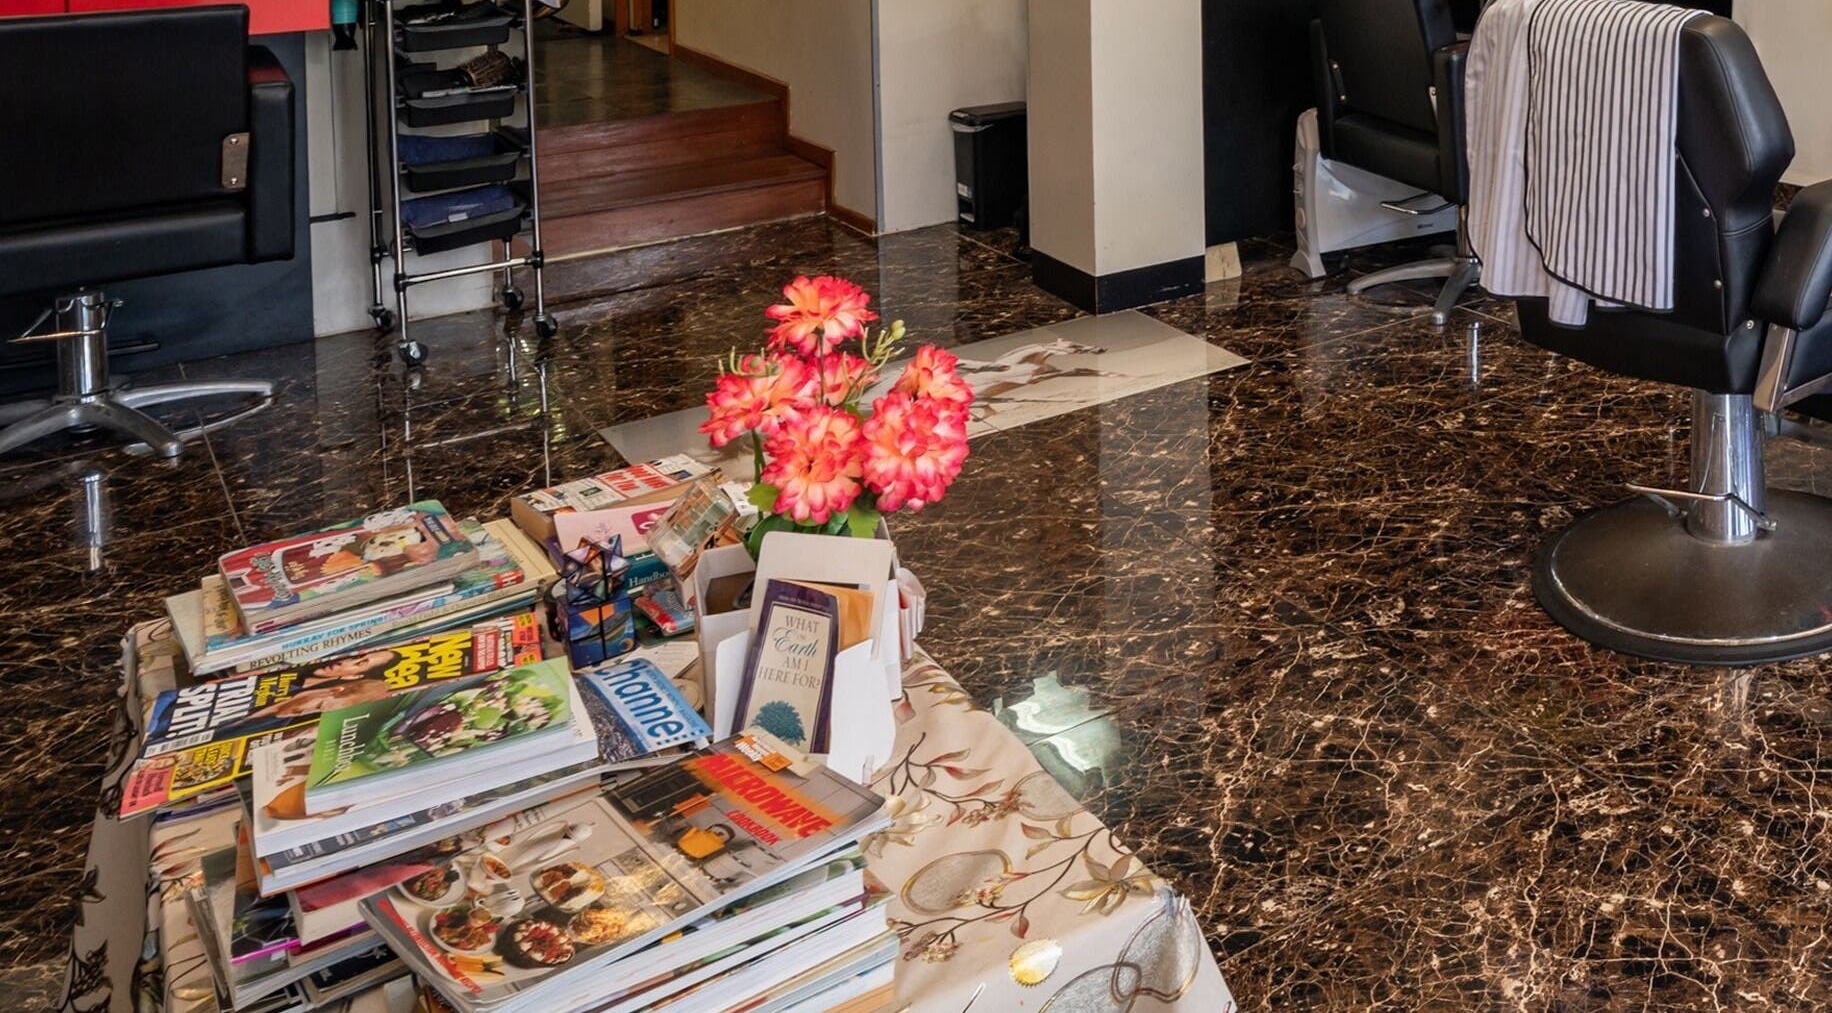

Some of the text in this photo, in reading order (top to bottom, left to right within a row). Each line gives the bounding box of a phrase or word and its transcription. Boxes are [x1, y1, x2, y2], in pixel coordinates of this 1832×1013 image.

[773, 627, 818, 658] Earth
[786, 615, 820, 633] WHAT
[250, 627, 372, 671] REVOLTING RHYMES
[427, 630, 472, 680] New
[783, 657, 809, 671] AM I
[758, 667, 821, 689] HERE FOR?
[165, 683, 218, 739] SPLIT!
[209, 675, 257, 728] TRIAL
[694, 753, 833, 839] MICROWAVE
